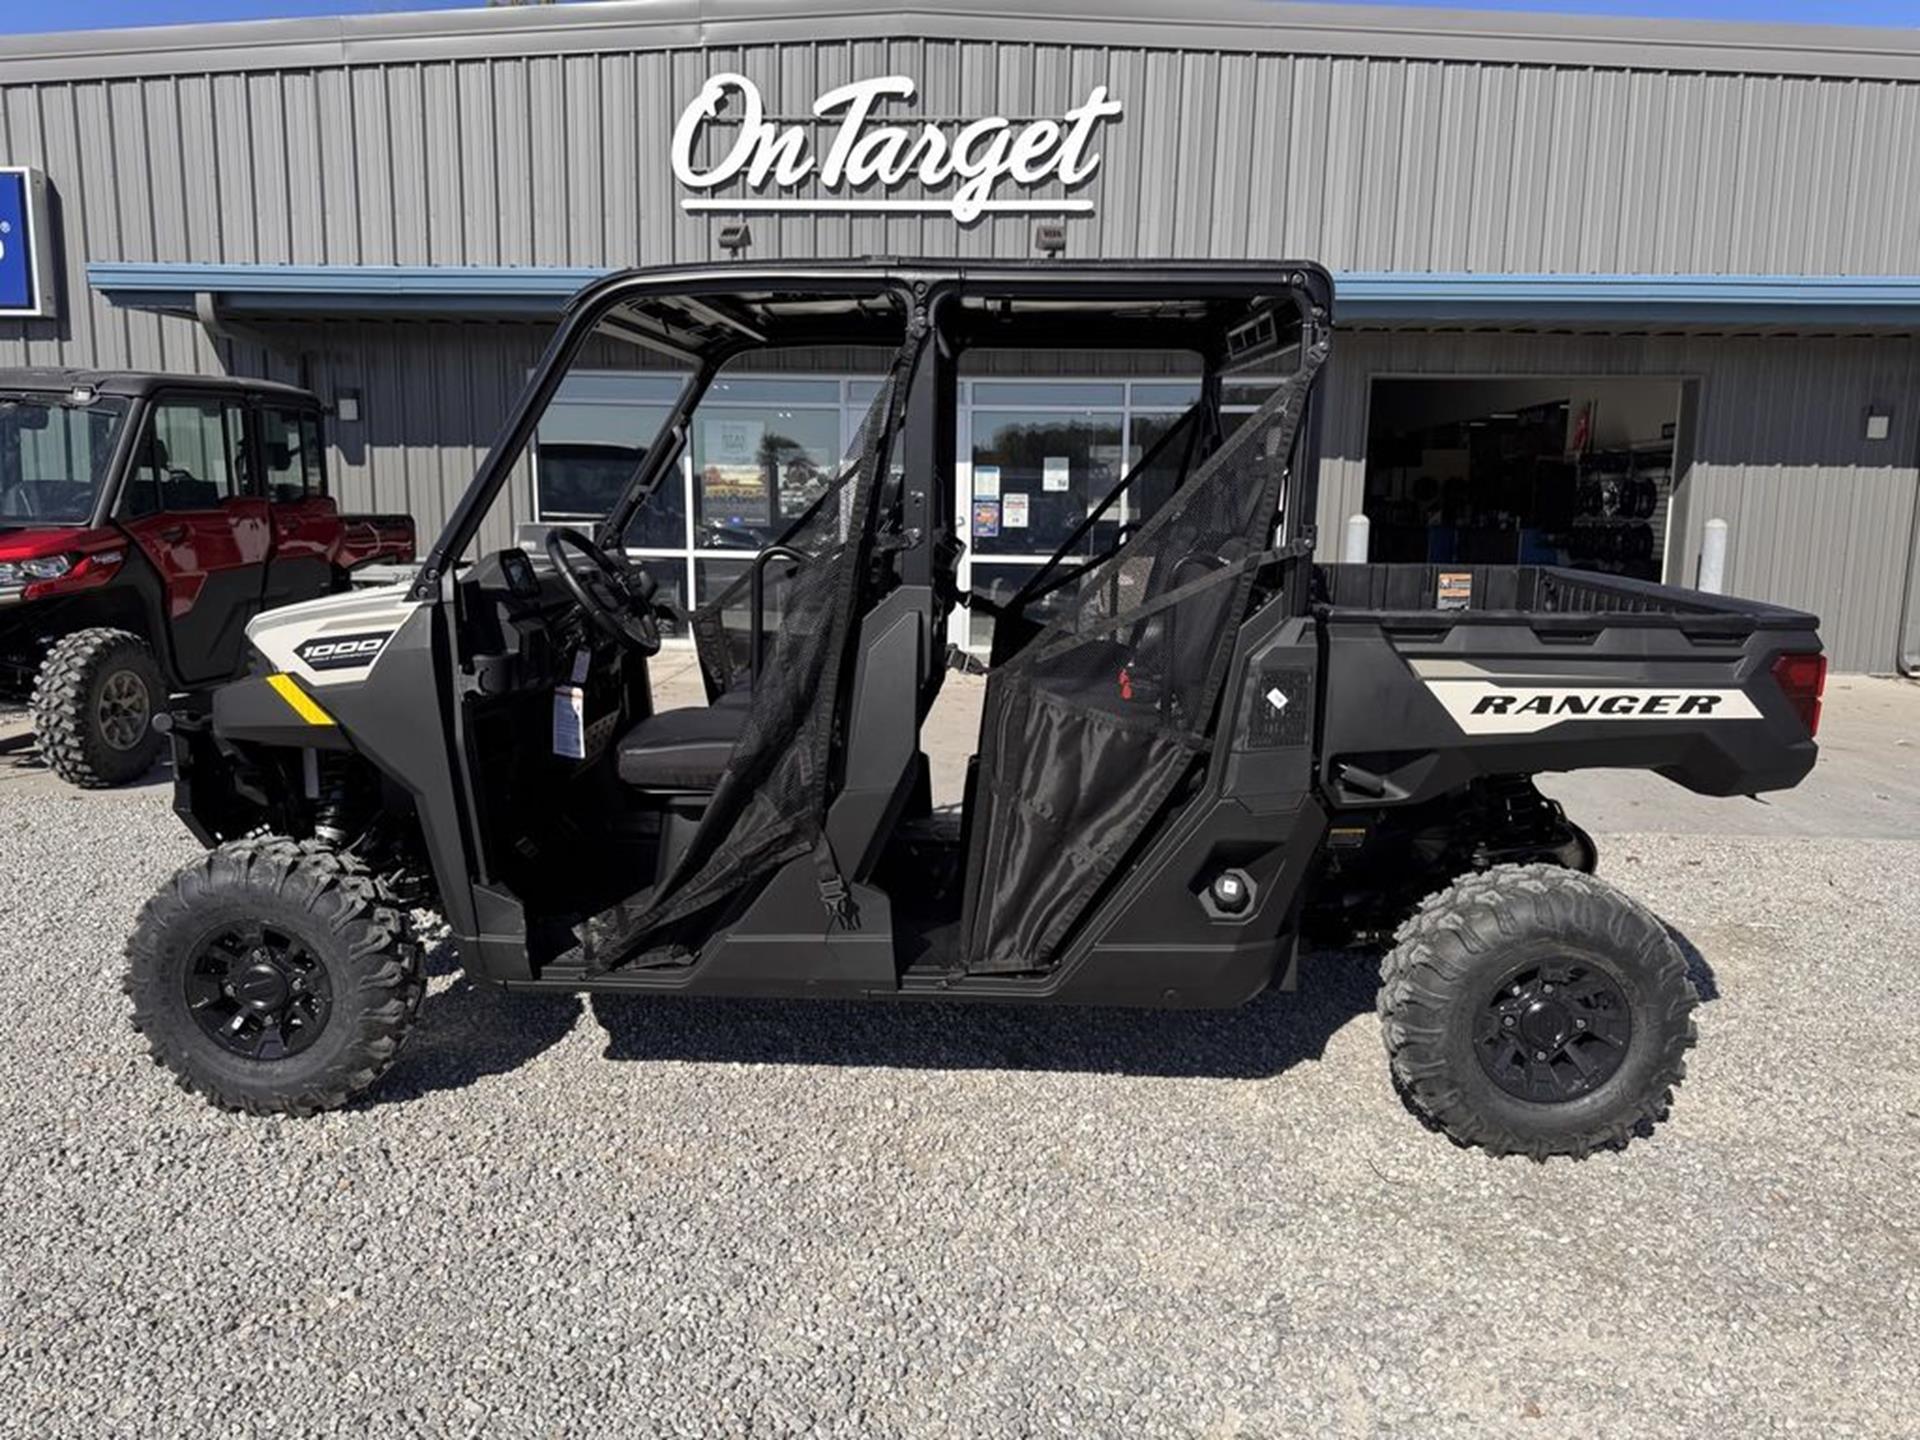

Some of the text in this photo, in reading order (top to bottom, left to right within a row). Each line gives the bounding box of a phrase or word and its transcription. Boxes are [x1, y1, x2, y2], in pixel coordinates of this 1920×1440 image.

[671, 73, 1122, 222] On Target
[303, 639, 384, 658] 1000
[1471, 695, 1722, 715] RANGER
